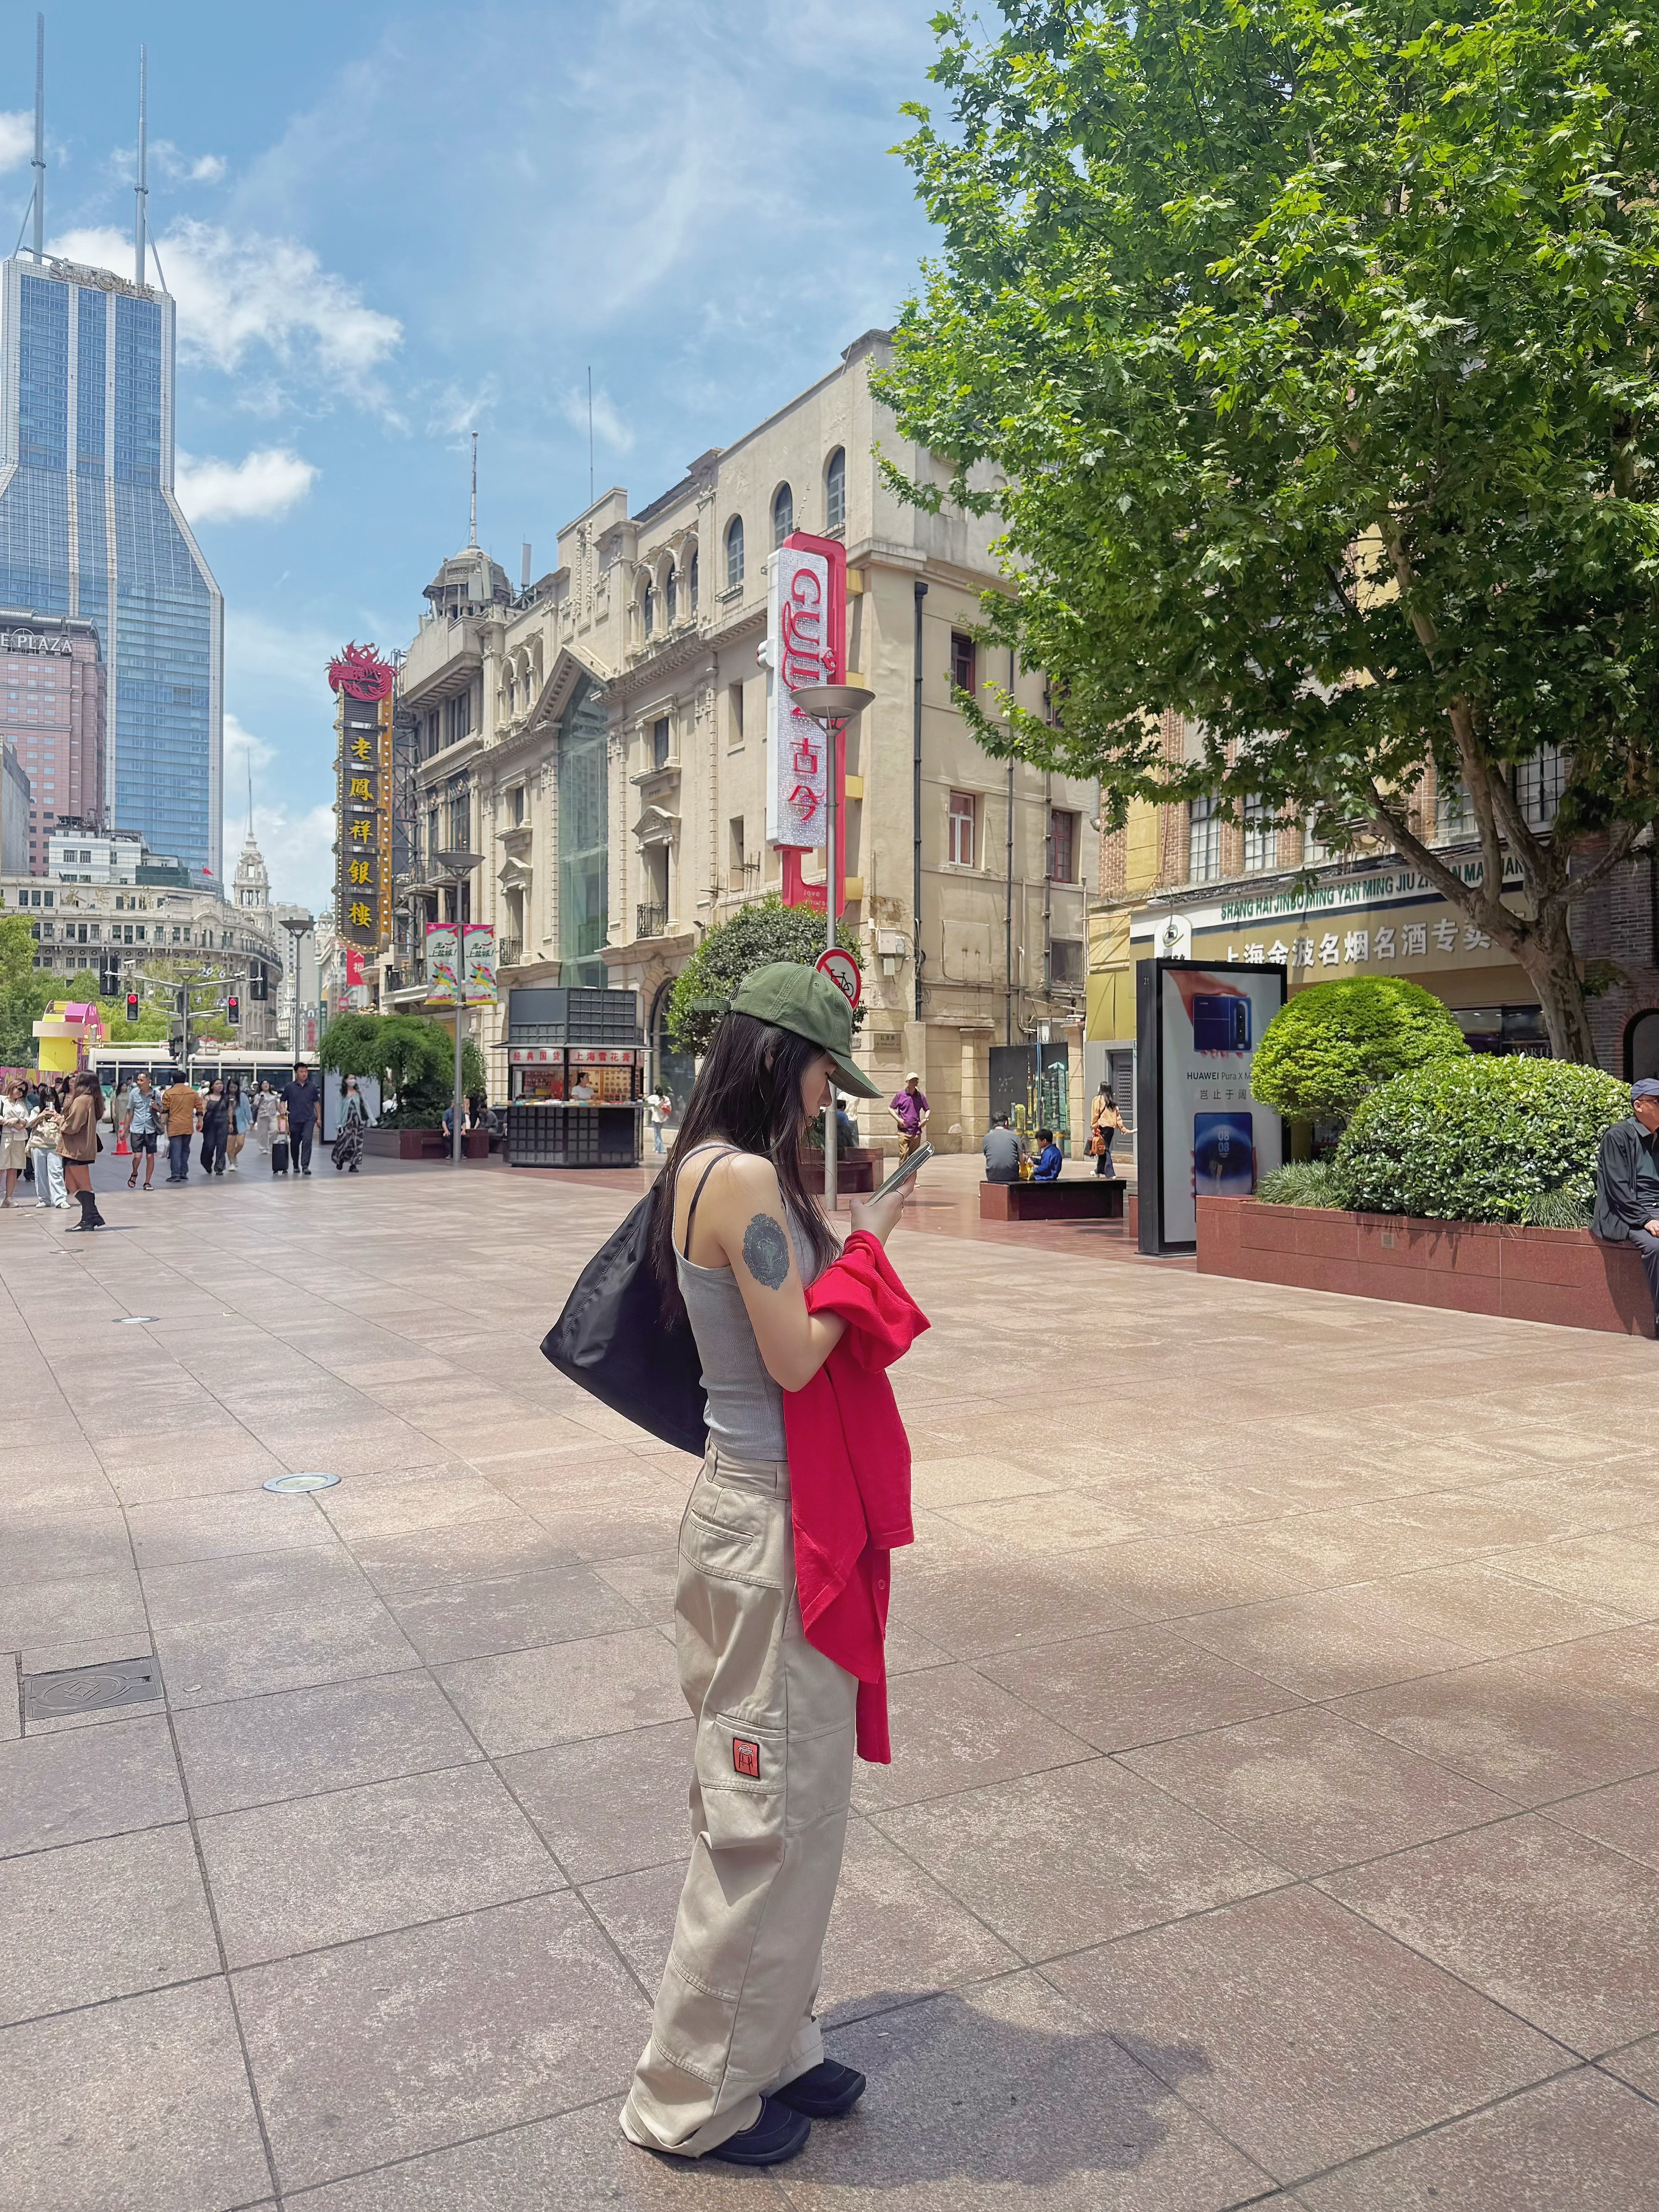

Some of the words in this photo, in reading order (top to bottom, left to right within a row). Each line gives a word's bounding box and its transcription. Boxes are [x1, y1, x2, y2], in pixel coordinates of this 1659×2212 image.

[17, 635, 72, 652] PLAZA
[787, 738, 825, 821] 古今
[1221, 899, 1253, 921] SHANG
[1256, 896, 1272, 916] HAI
[1306, 886, 1334, 909] MING
[1337, 882, 1360, 904] YAN
[1362, 876, 1393, 900] MING
[1396, 872, 1414, 891] JIU
[1464, 861, 1484, 882] MA
[1228, 910, 1525, 967] 上海金波名烟名酒专卖
[1144, 977, 1149, 985] 21
[514, 1051, 560, 1061] 经典国货
[575, 1052, 630, 1062] 上海雪花膏
[1218, 1131, 1229, 1141] 08
